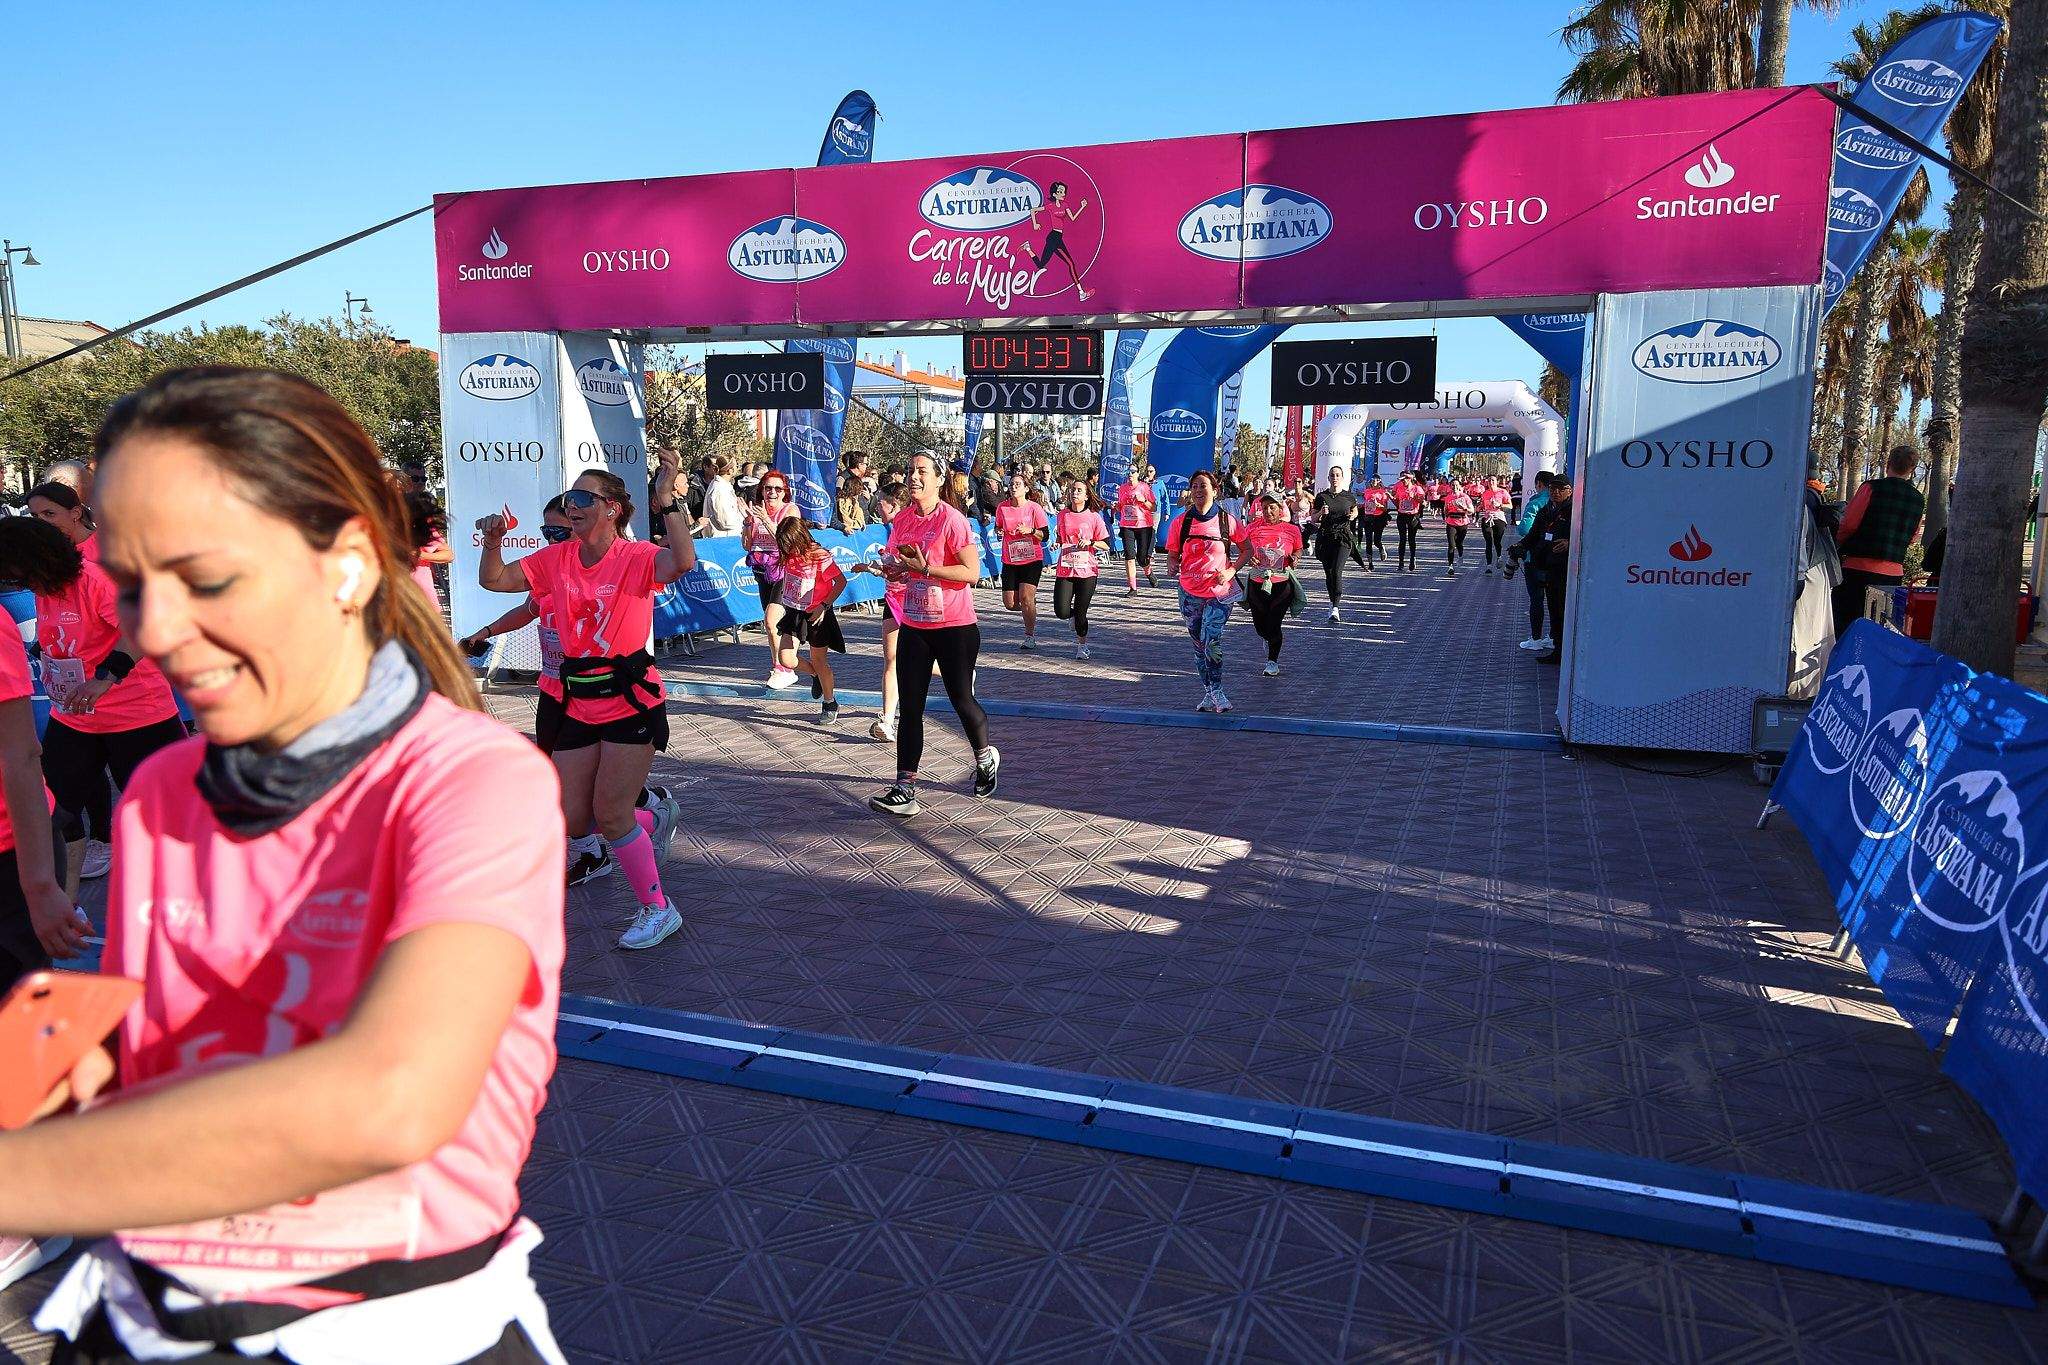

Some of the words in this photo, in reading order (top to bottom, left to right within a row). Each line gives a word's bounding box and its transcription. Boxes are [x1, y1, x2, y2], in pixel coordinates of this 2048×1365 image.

[1837, 133, 1912, 163] ASTURIANA
[947, 188, 987, 197] CENTRAL
[990, 186, 1030, 195] LECHERA
[928, 193, 1033, 217] ASTURIANA
[1266, 207, 1316, 217] LECHERA
[1413, 196, 1549, 231] OYSHO
[1636, 190, 1781, 220] Santander
[1189, 216, 1321, 244] ASTURIANA
[737, 242, 838, 267] ASTURIANA
[908, 228, 1010, 262] Carrera
[458, 262, 533, 282] Santander
[583, 248, 670, 274] OYSHO
[932, 262, 952, 286] de
[956, 260, 969, 285] la
[966, 255, 1048, 311] Mujer
[972, 337, 1094, 369] 00:43:37
[1666, 341, 1713, 350] CENTRAL
[1717, 340, 1767, 349] LECHERA
[1642, 347, 1770, 369] ASTURIANA
[466, 371, 536, 390] ASTURIANA
[723, 371, 808, 394] OYSHO
[1297, 360, 1412, 387] OYSHO
[970, 381, 1097, 410] OYSHO
[1153, 419, 1203, 434] ASTURIANA
[460, 441, 544, 463] OYSHO
[578, 441, 638, 465] OYSHO
[1620, 439, 1774, 469] OYSHO
[1287, 451, 1299, 482] Sports
[472, 533, 542, 548] Sander
[684, 576, 730, 593] ASTURIANA
[1626, 564, 1753, 587] Santander
[1854, 734, 1914, 823] ASTURIANA
[1915, 799, 2003, 916] ASTURIANA
